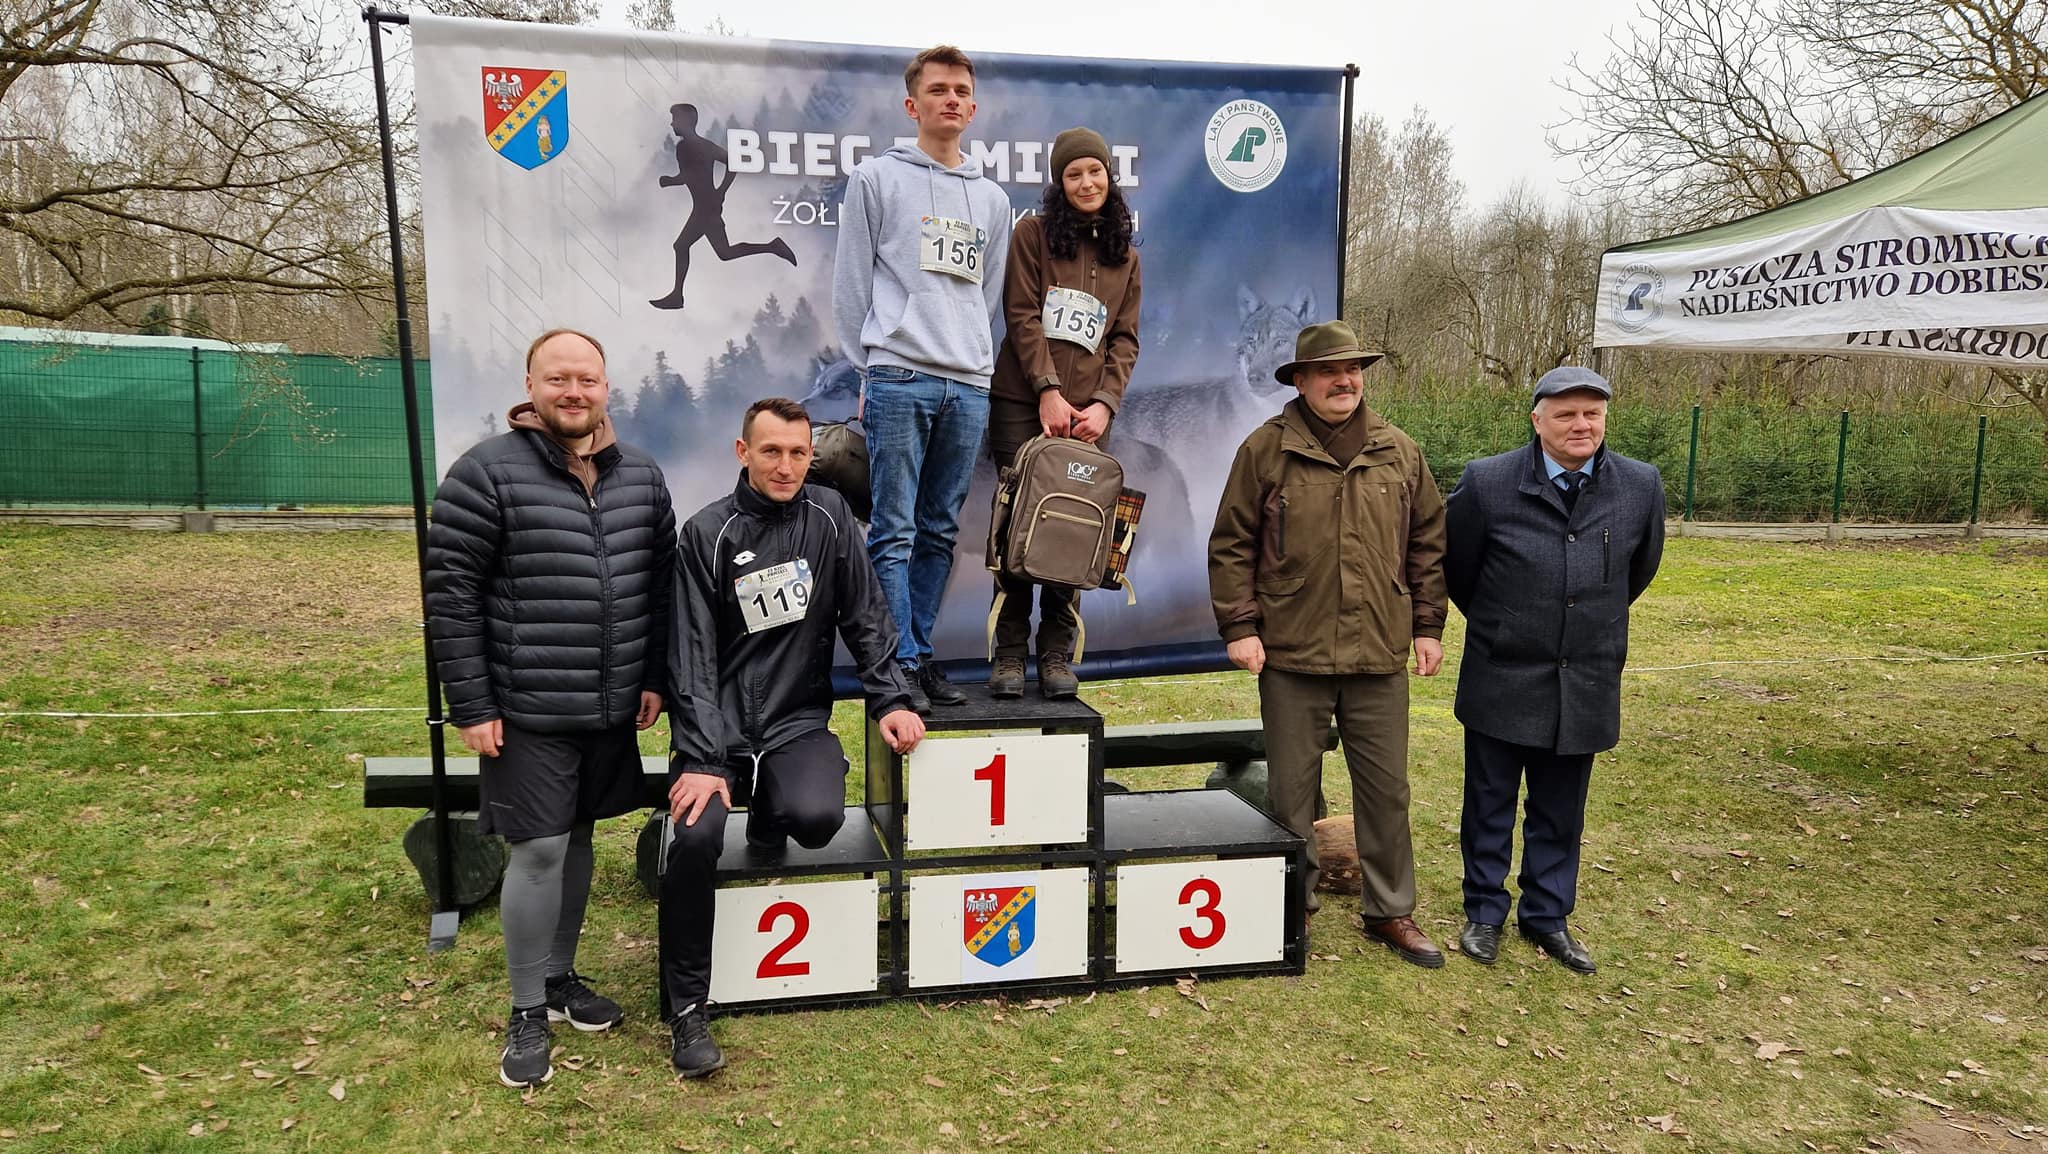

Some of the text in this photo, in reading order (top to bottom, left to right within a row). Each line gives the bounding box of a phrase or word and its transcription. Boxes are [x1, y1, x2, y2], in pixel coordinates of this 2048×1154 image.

[1208, 112, 1226, 142] LASY
[727, 128, 874, 177] BIEG
[932, 237, 977, 271] 156
[1686, 249, 1827, 292] PUSZCZA
[1679, 272, 1900, 317] NADLEŚNICTWO
[1052, 307, 1098, 340] 155
[752, 582, 808, 619] 119
[974, 754, 1006, 826] 1
[1178, 878, 1226, 950] 3
[755, 901, 811, 980] 2
